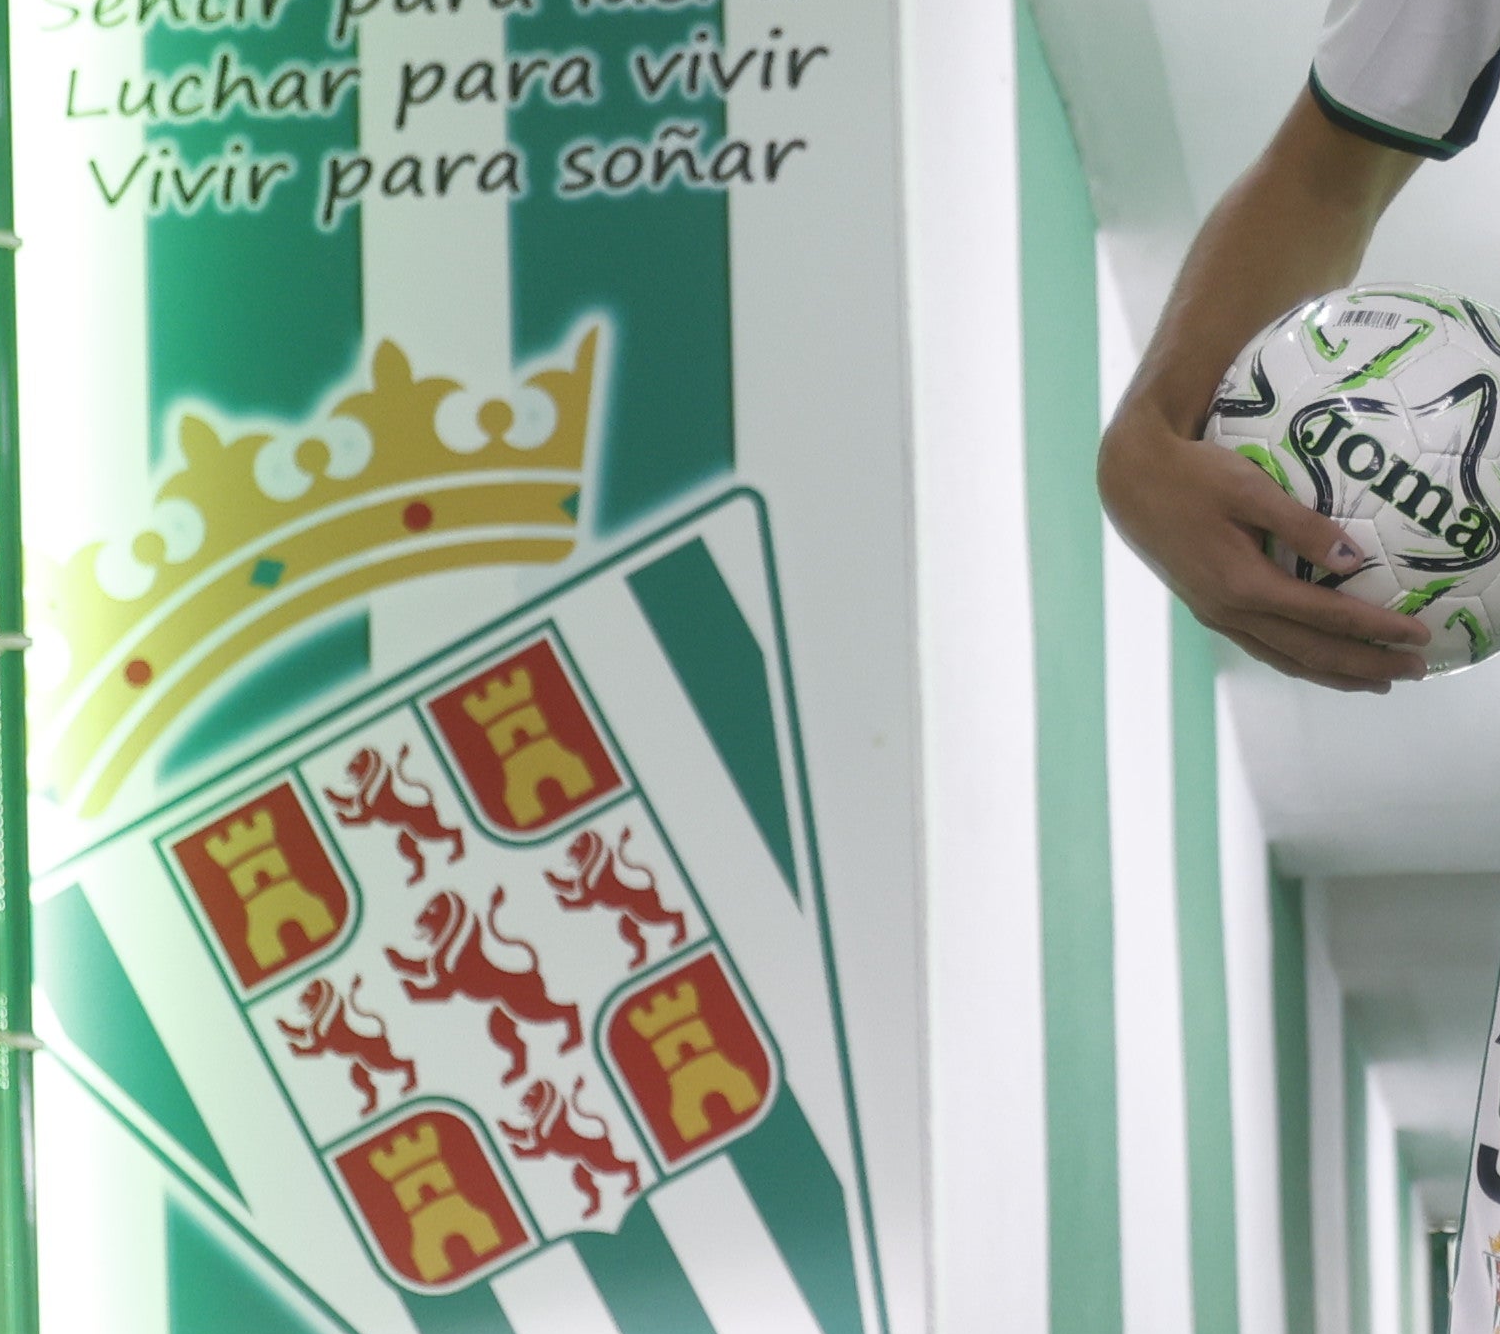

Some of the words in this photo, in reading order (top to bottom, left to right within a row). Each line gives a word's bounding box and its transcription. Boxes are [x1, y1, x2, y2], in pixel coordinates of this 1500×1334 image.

[65, 53, 362, 122] Luchar
[393, 50, 596, 130] para
[633, 29, 830, 101] vivir
[88, 142, 291, 208] Vivir
[319, 144, 522, 228] para
[558, 124, 808, 197] soñar
[1300, 408, 1491, 559] Joma
